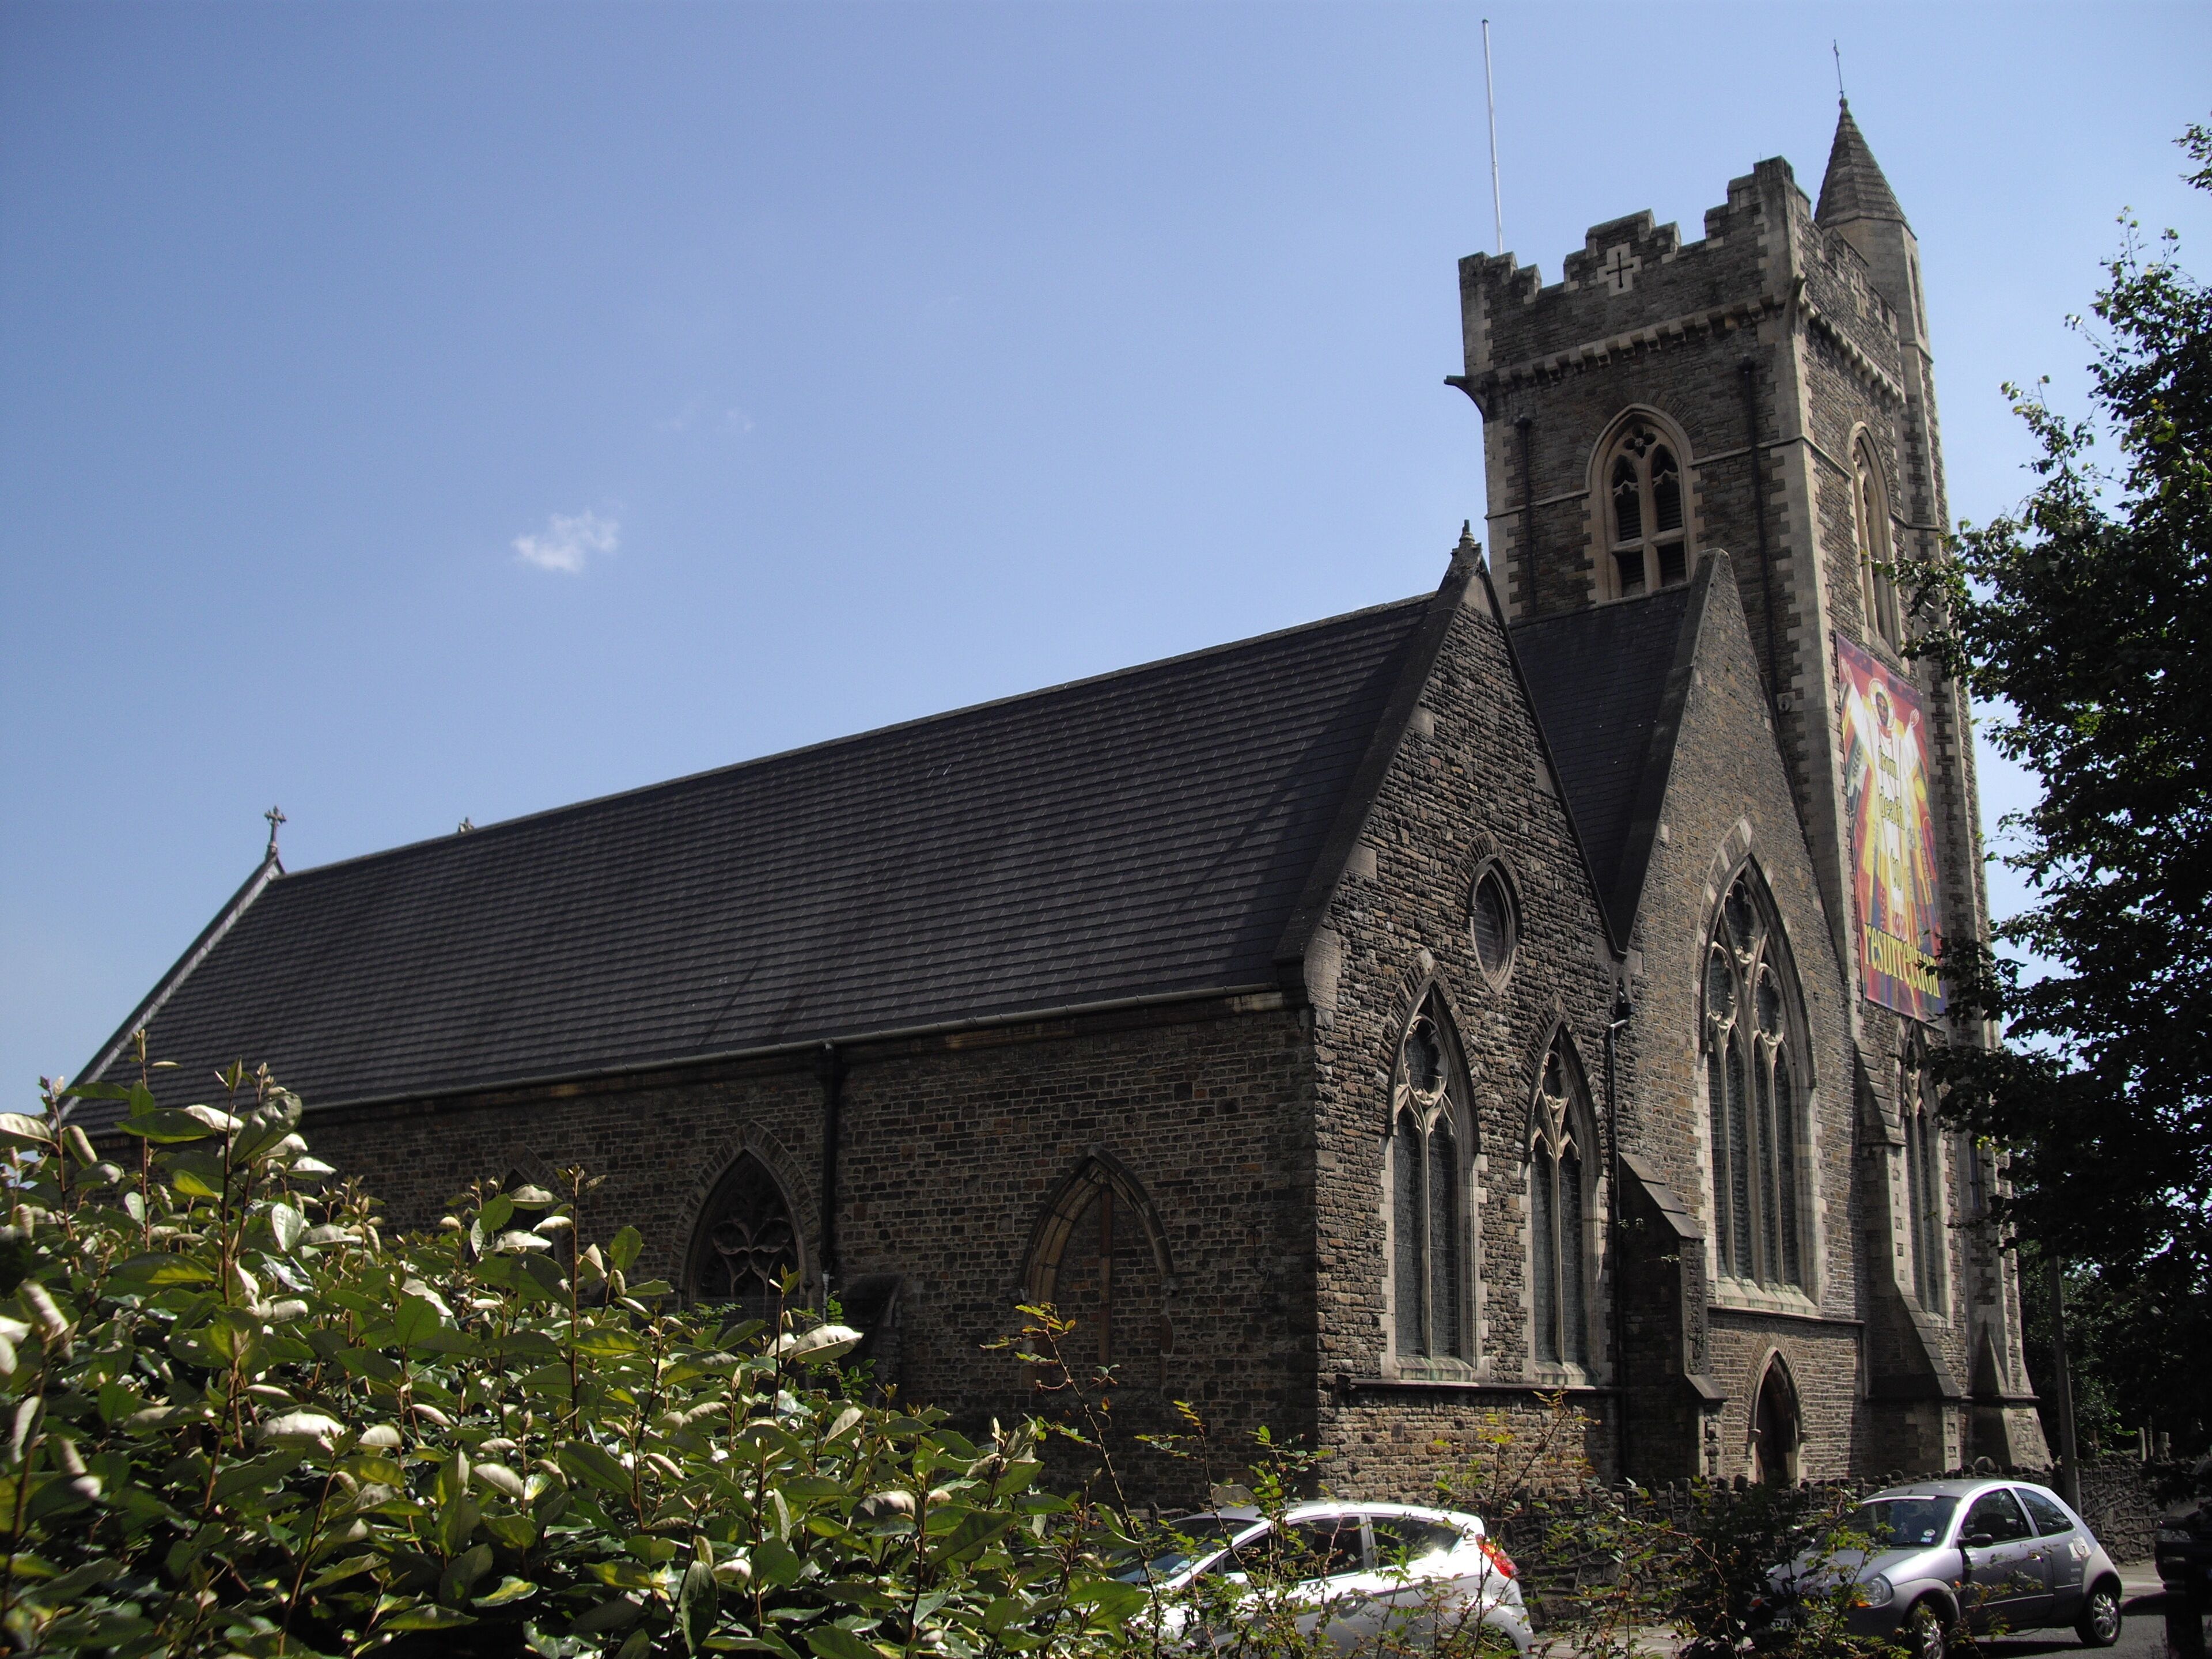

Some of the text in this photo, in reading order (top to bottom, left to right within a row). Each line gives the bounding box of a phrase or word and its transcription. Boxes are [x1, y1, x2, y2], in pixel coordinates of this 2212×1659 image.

[1878, 745, 1899, 781] from
[1878, 786, 1906, 831] death
[1889, 847, 1903, 891] to
[1864, 923, 1941, 998] resurrection
